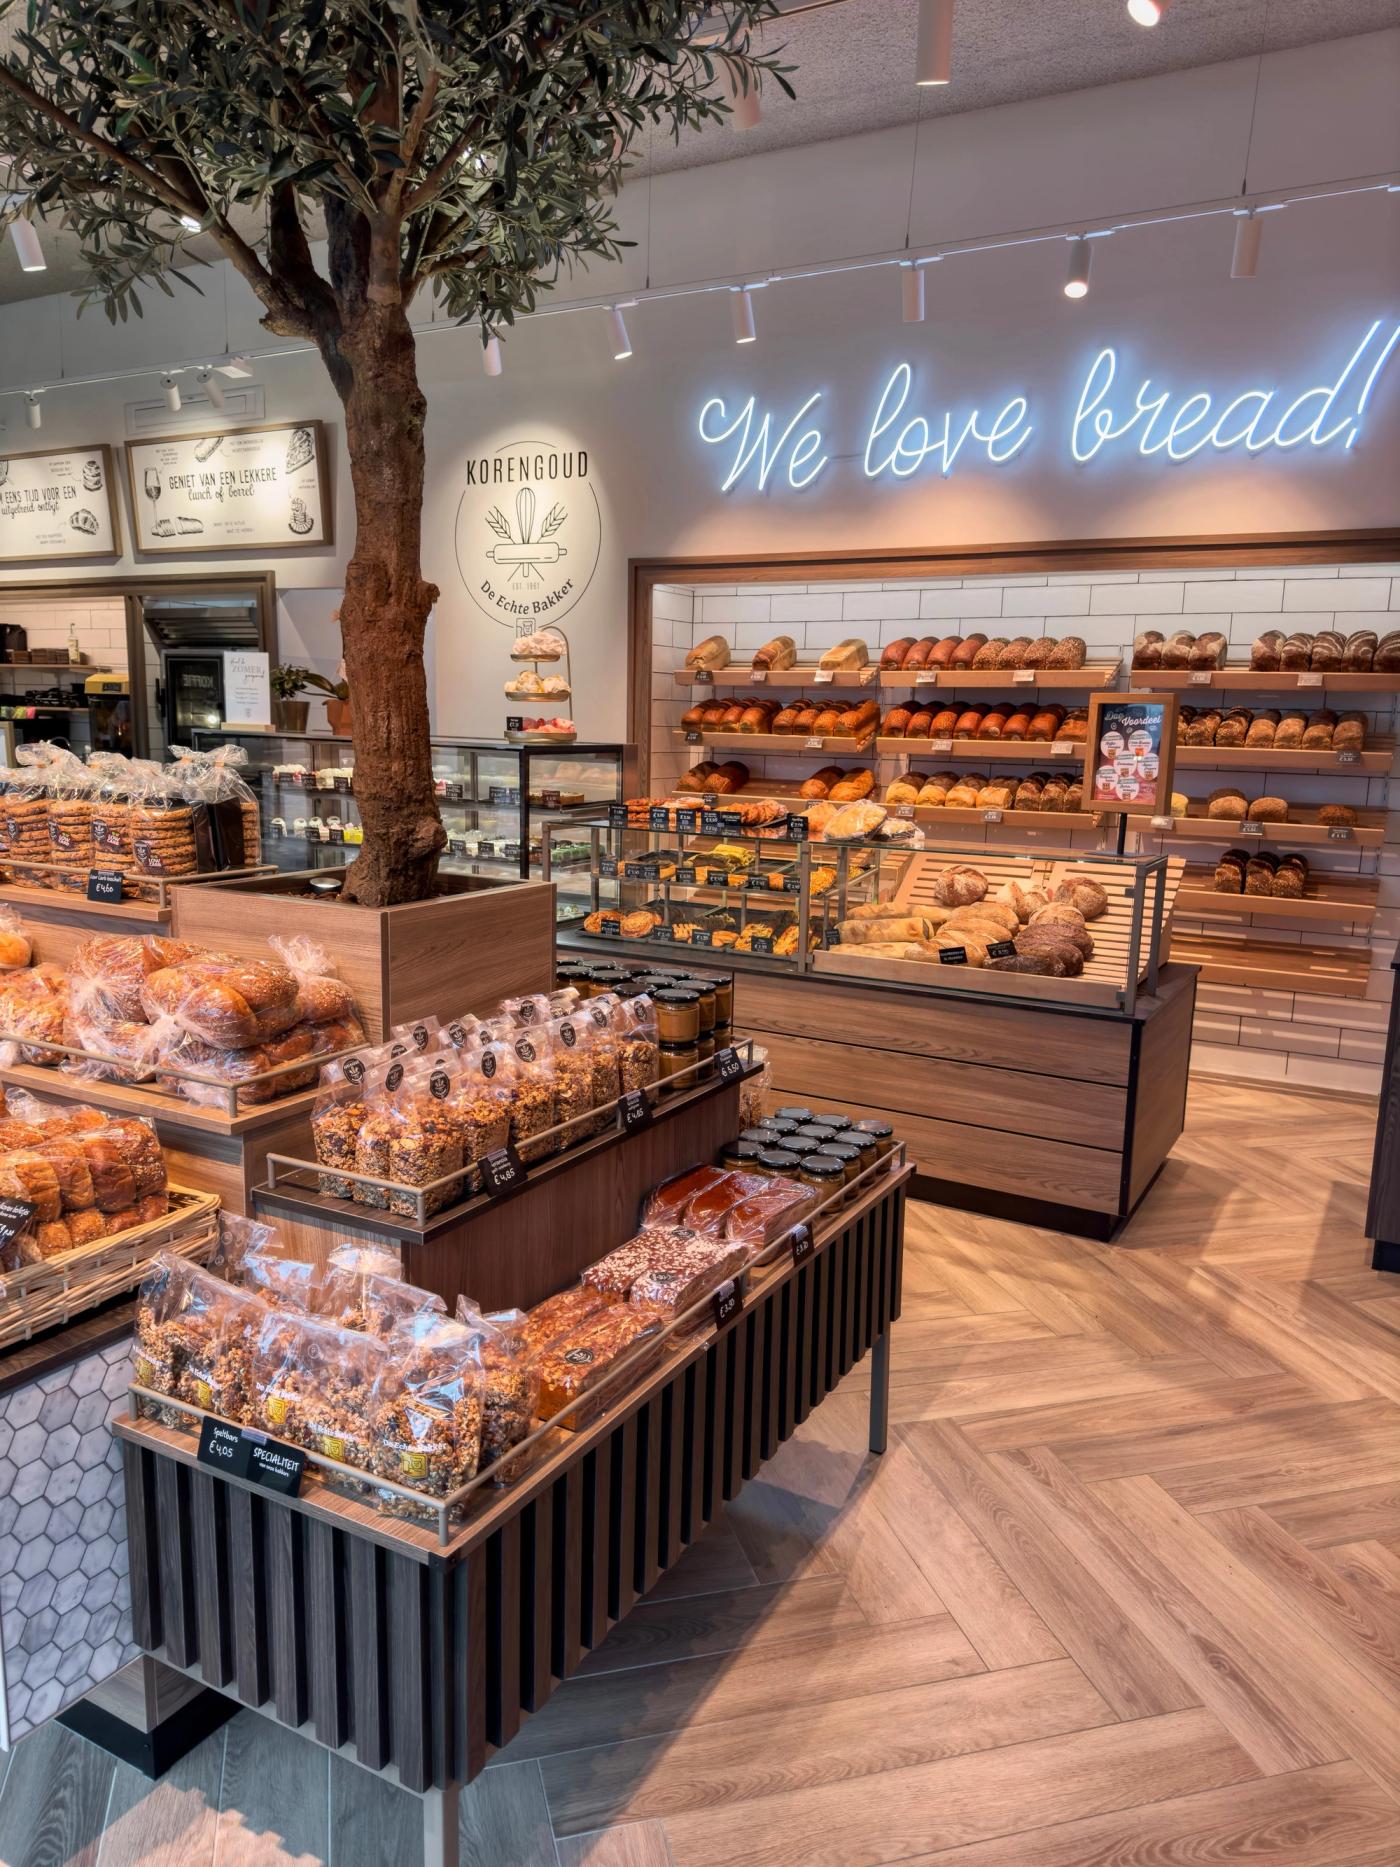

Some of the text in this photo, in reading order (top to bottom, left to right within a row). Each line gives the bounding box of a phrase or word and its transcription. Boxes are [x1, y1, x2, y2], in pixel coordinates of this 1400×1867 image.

[697, 320, 1400, 492] We love bread!
[168, 467, 278, 490] GENIET VAN EEN LEKKERE
[466, 451, 588, 485] KORENGOUD
[5, 485, 77, 504] EENS TIJD VOOR EEN
[188, 484, 255, 503] lunch of borrel
[480, 578, 576, 615] De Echte Bakker
[1121, 715, 1162, 726] Voordeel
[253, 1447, 300, 1472] SPECIALITEIT
